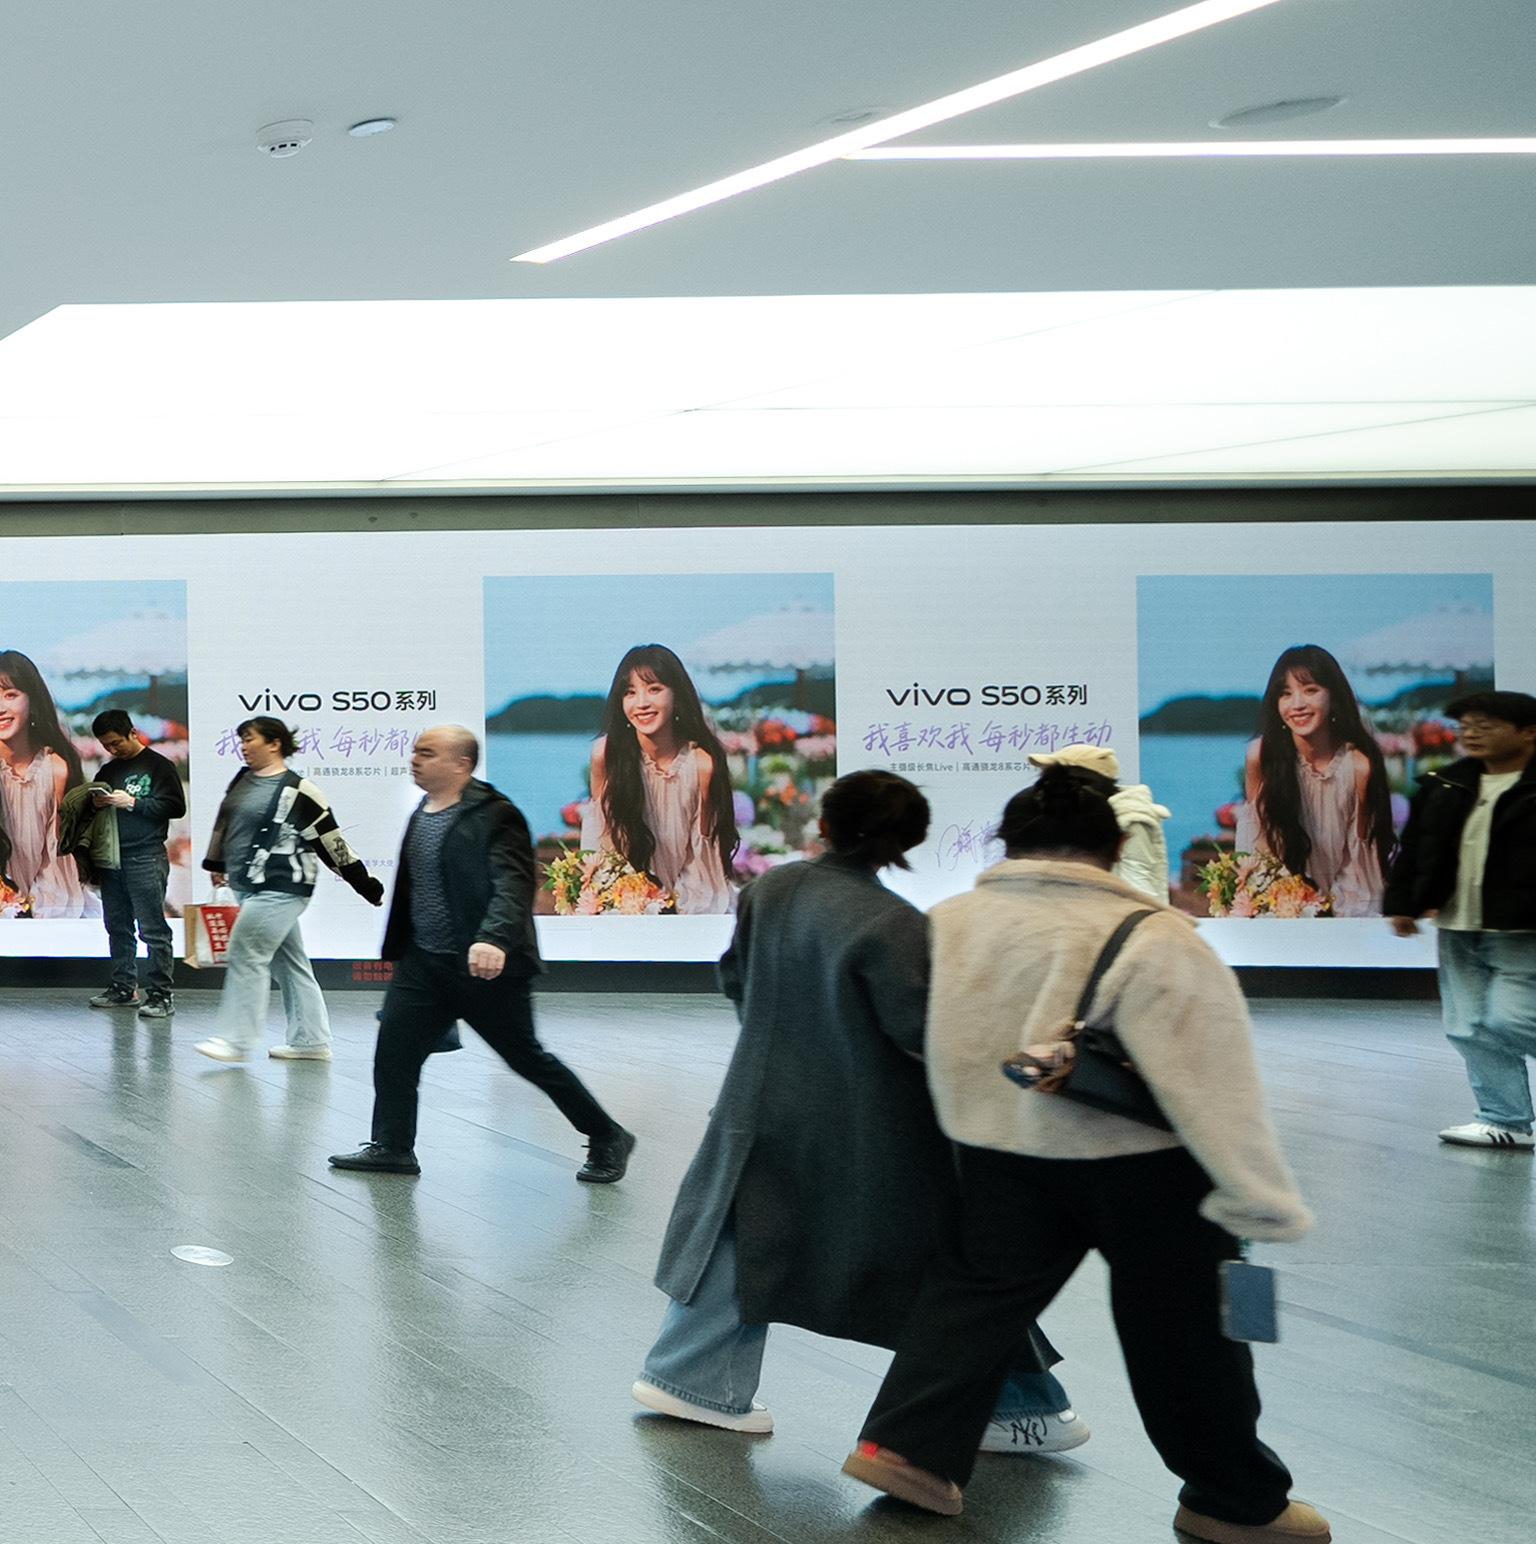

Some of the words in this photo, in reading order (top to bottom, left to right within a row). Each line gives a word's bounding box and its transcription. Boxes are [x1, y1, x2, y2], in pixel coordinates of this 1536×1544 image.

[238, 688, 322, 711] vivo
[332, 690, 436, 711] S50系列
[886, 682, 971, 706] vivo
[981, 684, 1087, 706] S50系列
[215, 728, 325, 761] 我我
[863, 722, 973, 756] 我喜欢我
[979, 719, 1112, 752] 每秒都生动
